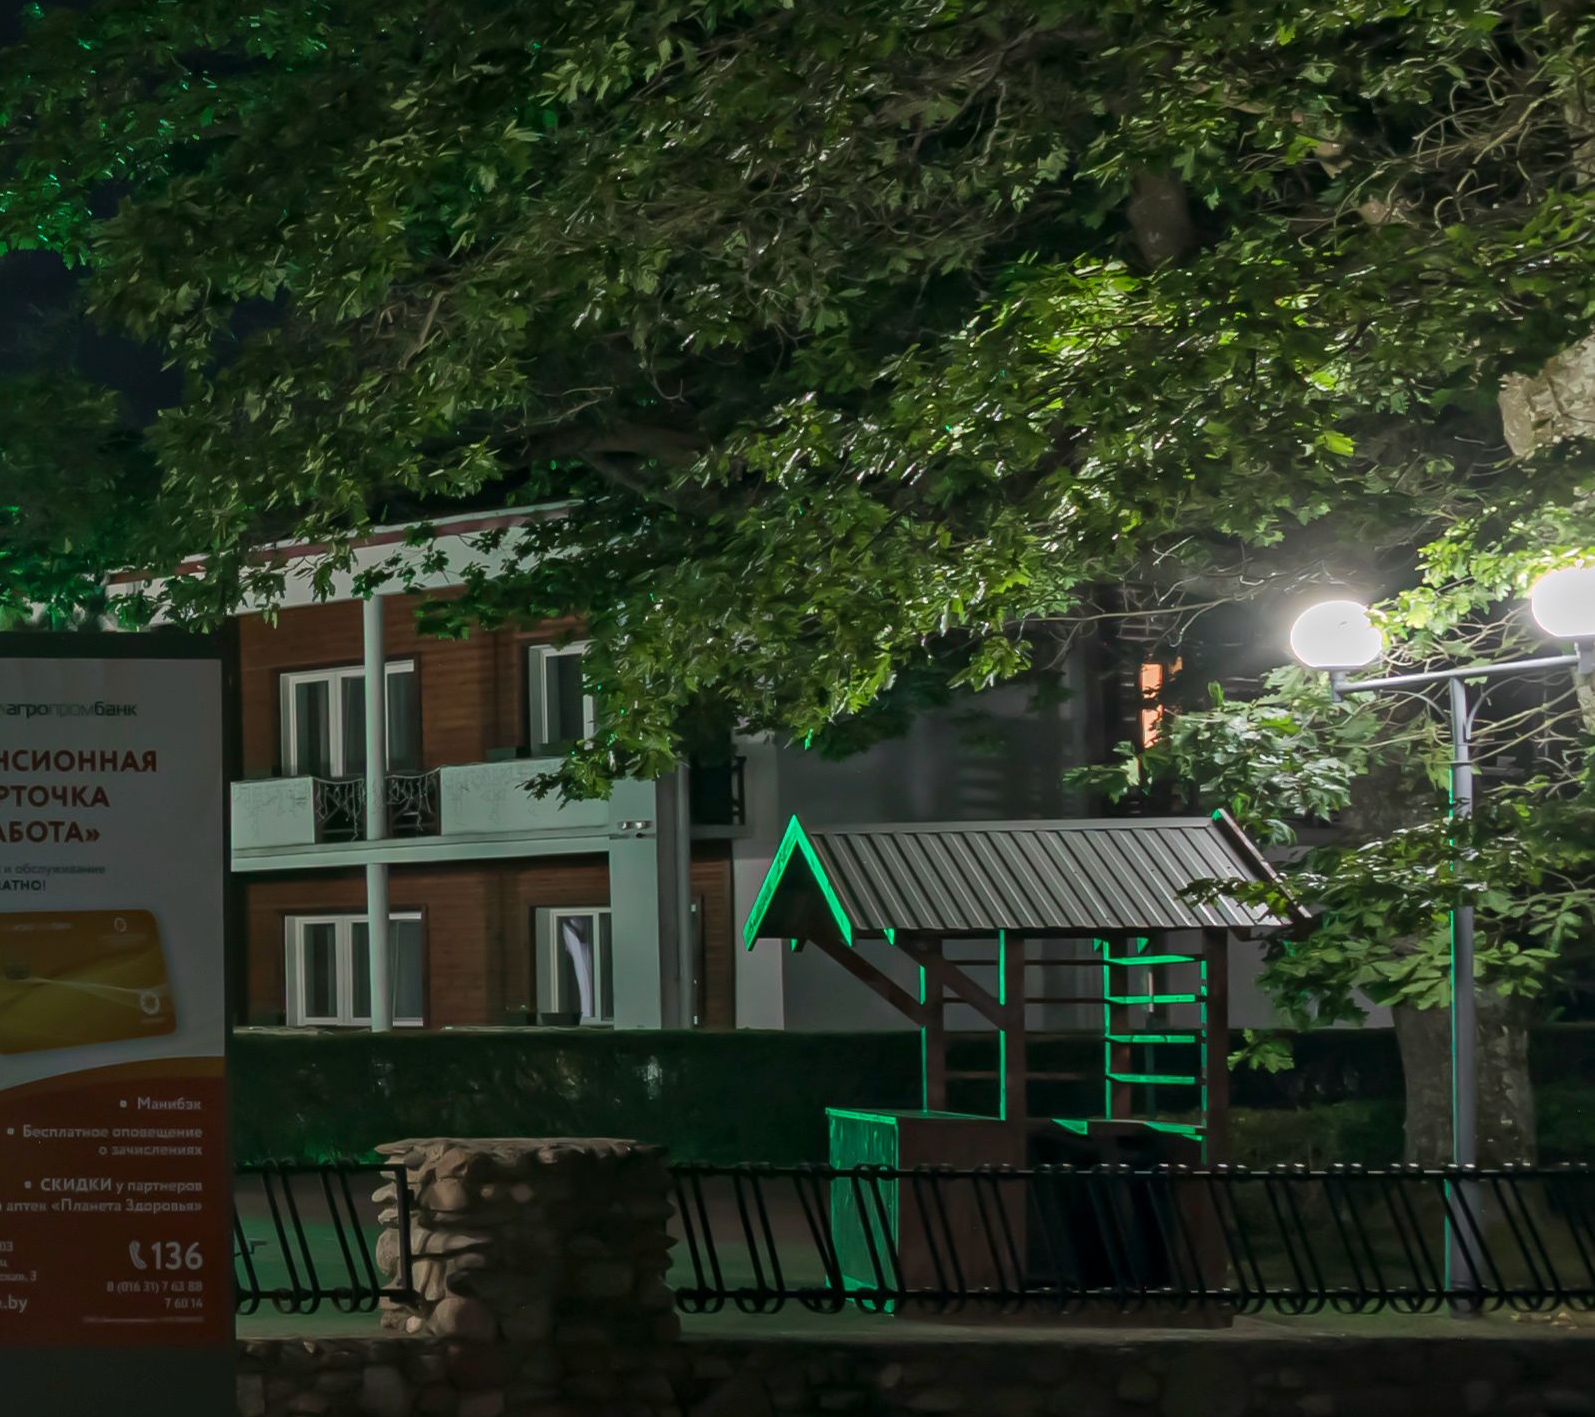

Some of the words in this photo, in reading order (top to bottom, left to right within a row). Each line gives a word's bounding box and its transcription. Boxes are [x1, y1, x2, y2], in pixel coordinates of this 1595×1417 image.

[4, 866, 11, 874] и
[15, 863, 105, 876] обслуживание
[137, 1096, 202, 1110] Манибэк
[23, 1124, 109, 1138] Бесплатное
[112, 1127, 203, 1139] оповещение
[98, 1146, 108, 1156] о
[111, 1146, 203, 1156] зачислениях
[40, 1178, 112, 1192] СКИДКИ
[116, 1182, 124, 1194] у
[127, 1182, 203, 1194] партнеров
[6, 1202, 47, 1212] аптек
[151, 1241, 203, 1271] 136
